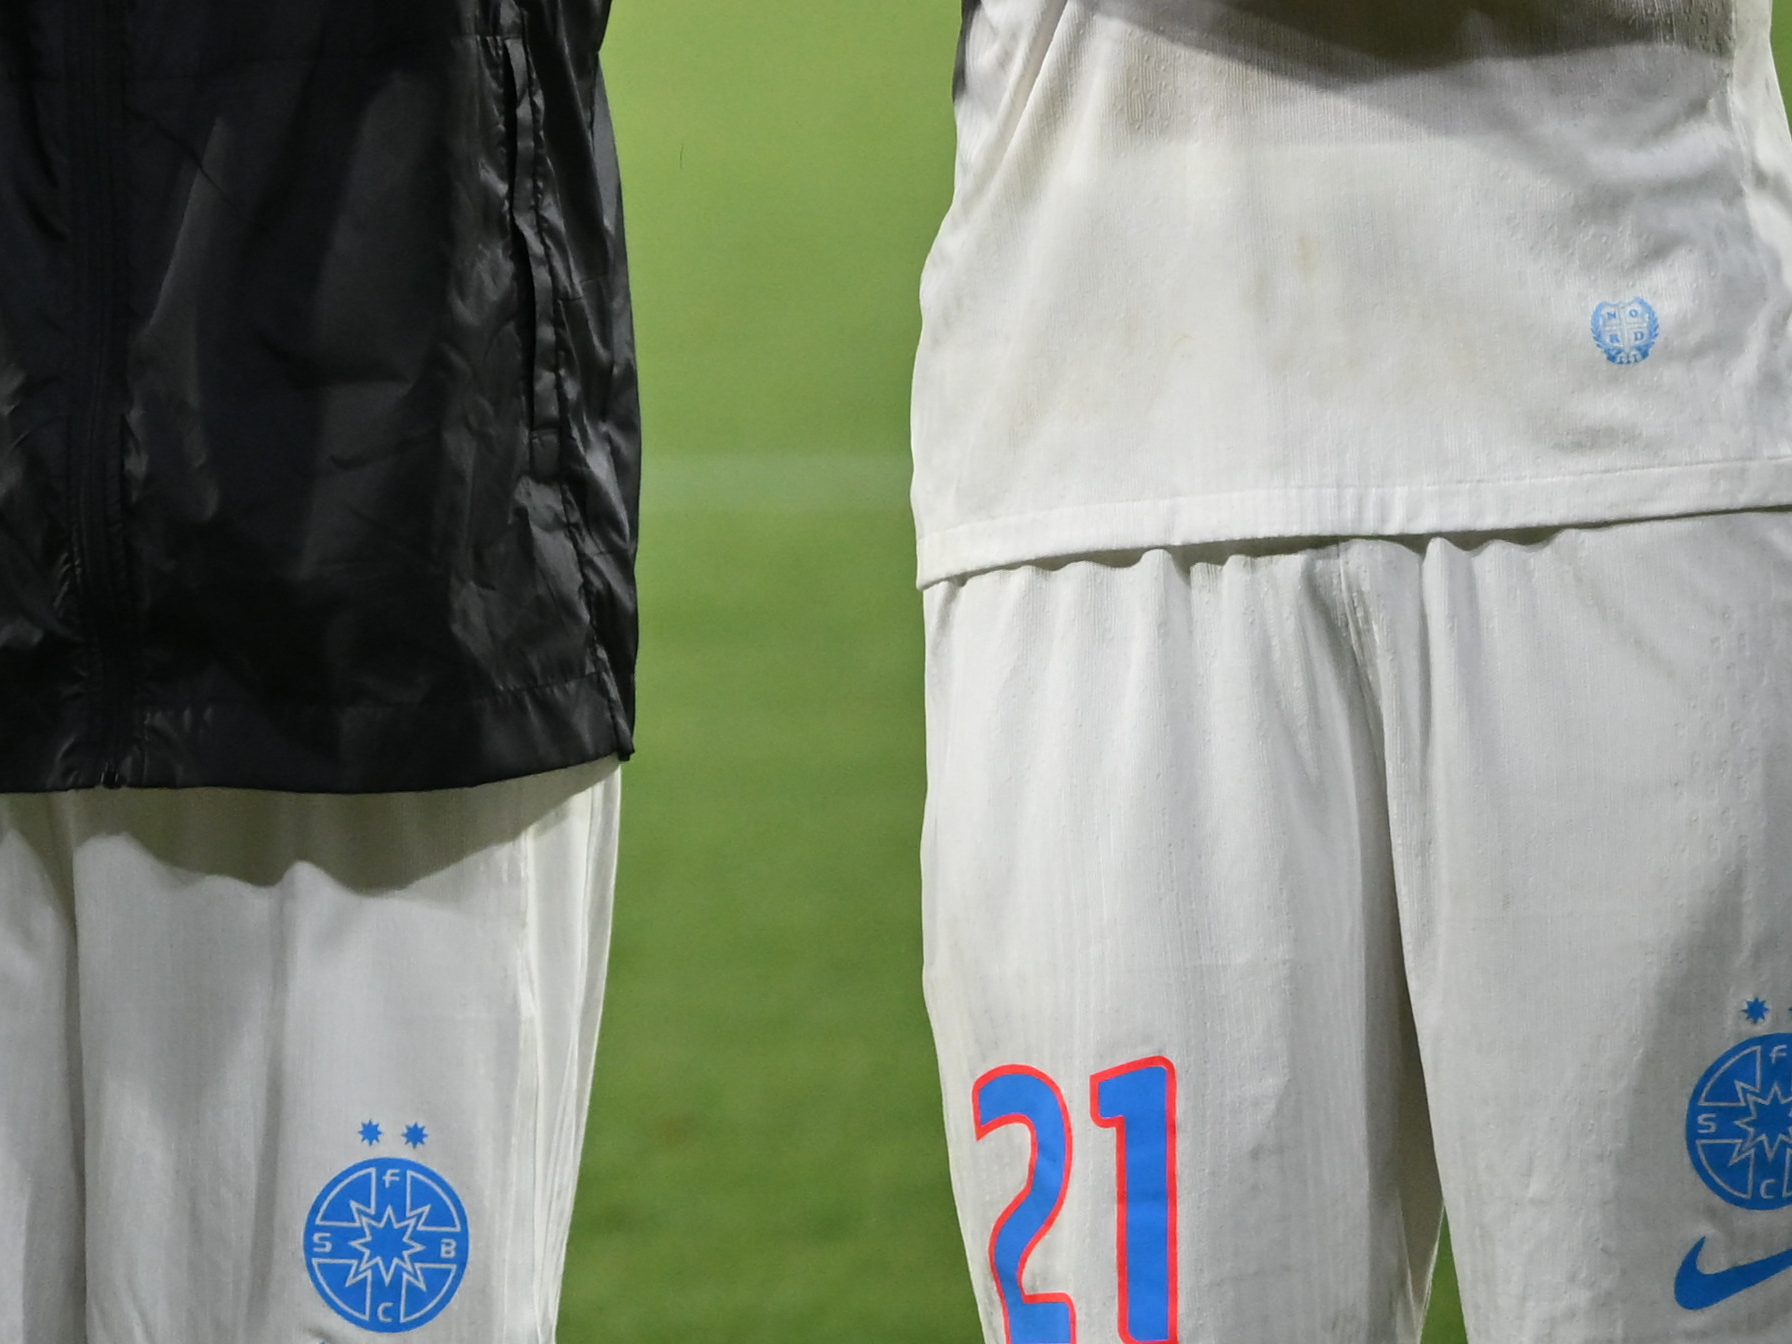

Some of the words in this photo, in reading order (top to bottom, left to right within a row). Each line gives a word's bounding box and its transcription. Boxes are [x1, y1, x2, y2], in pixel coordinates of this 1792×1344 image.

[1629, 308, 1639, 318] O
[1633, 330, 1646, 342] D
[1696, 1112, 1717, 1134] S
[972, 1055, 1179, 1344] 21
[1759, 1178, 1776, 1200] C
[311, 1232, 333, 1254] S
[439, 1238, 458, 1259] B
[376, 1302, 394, 1323] C
